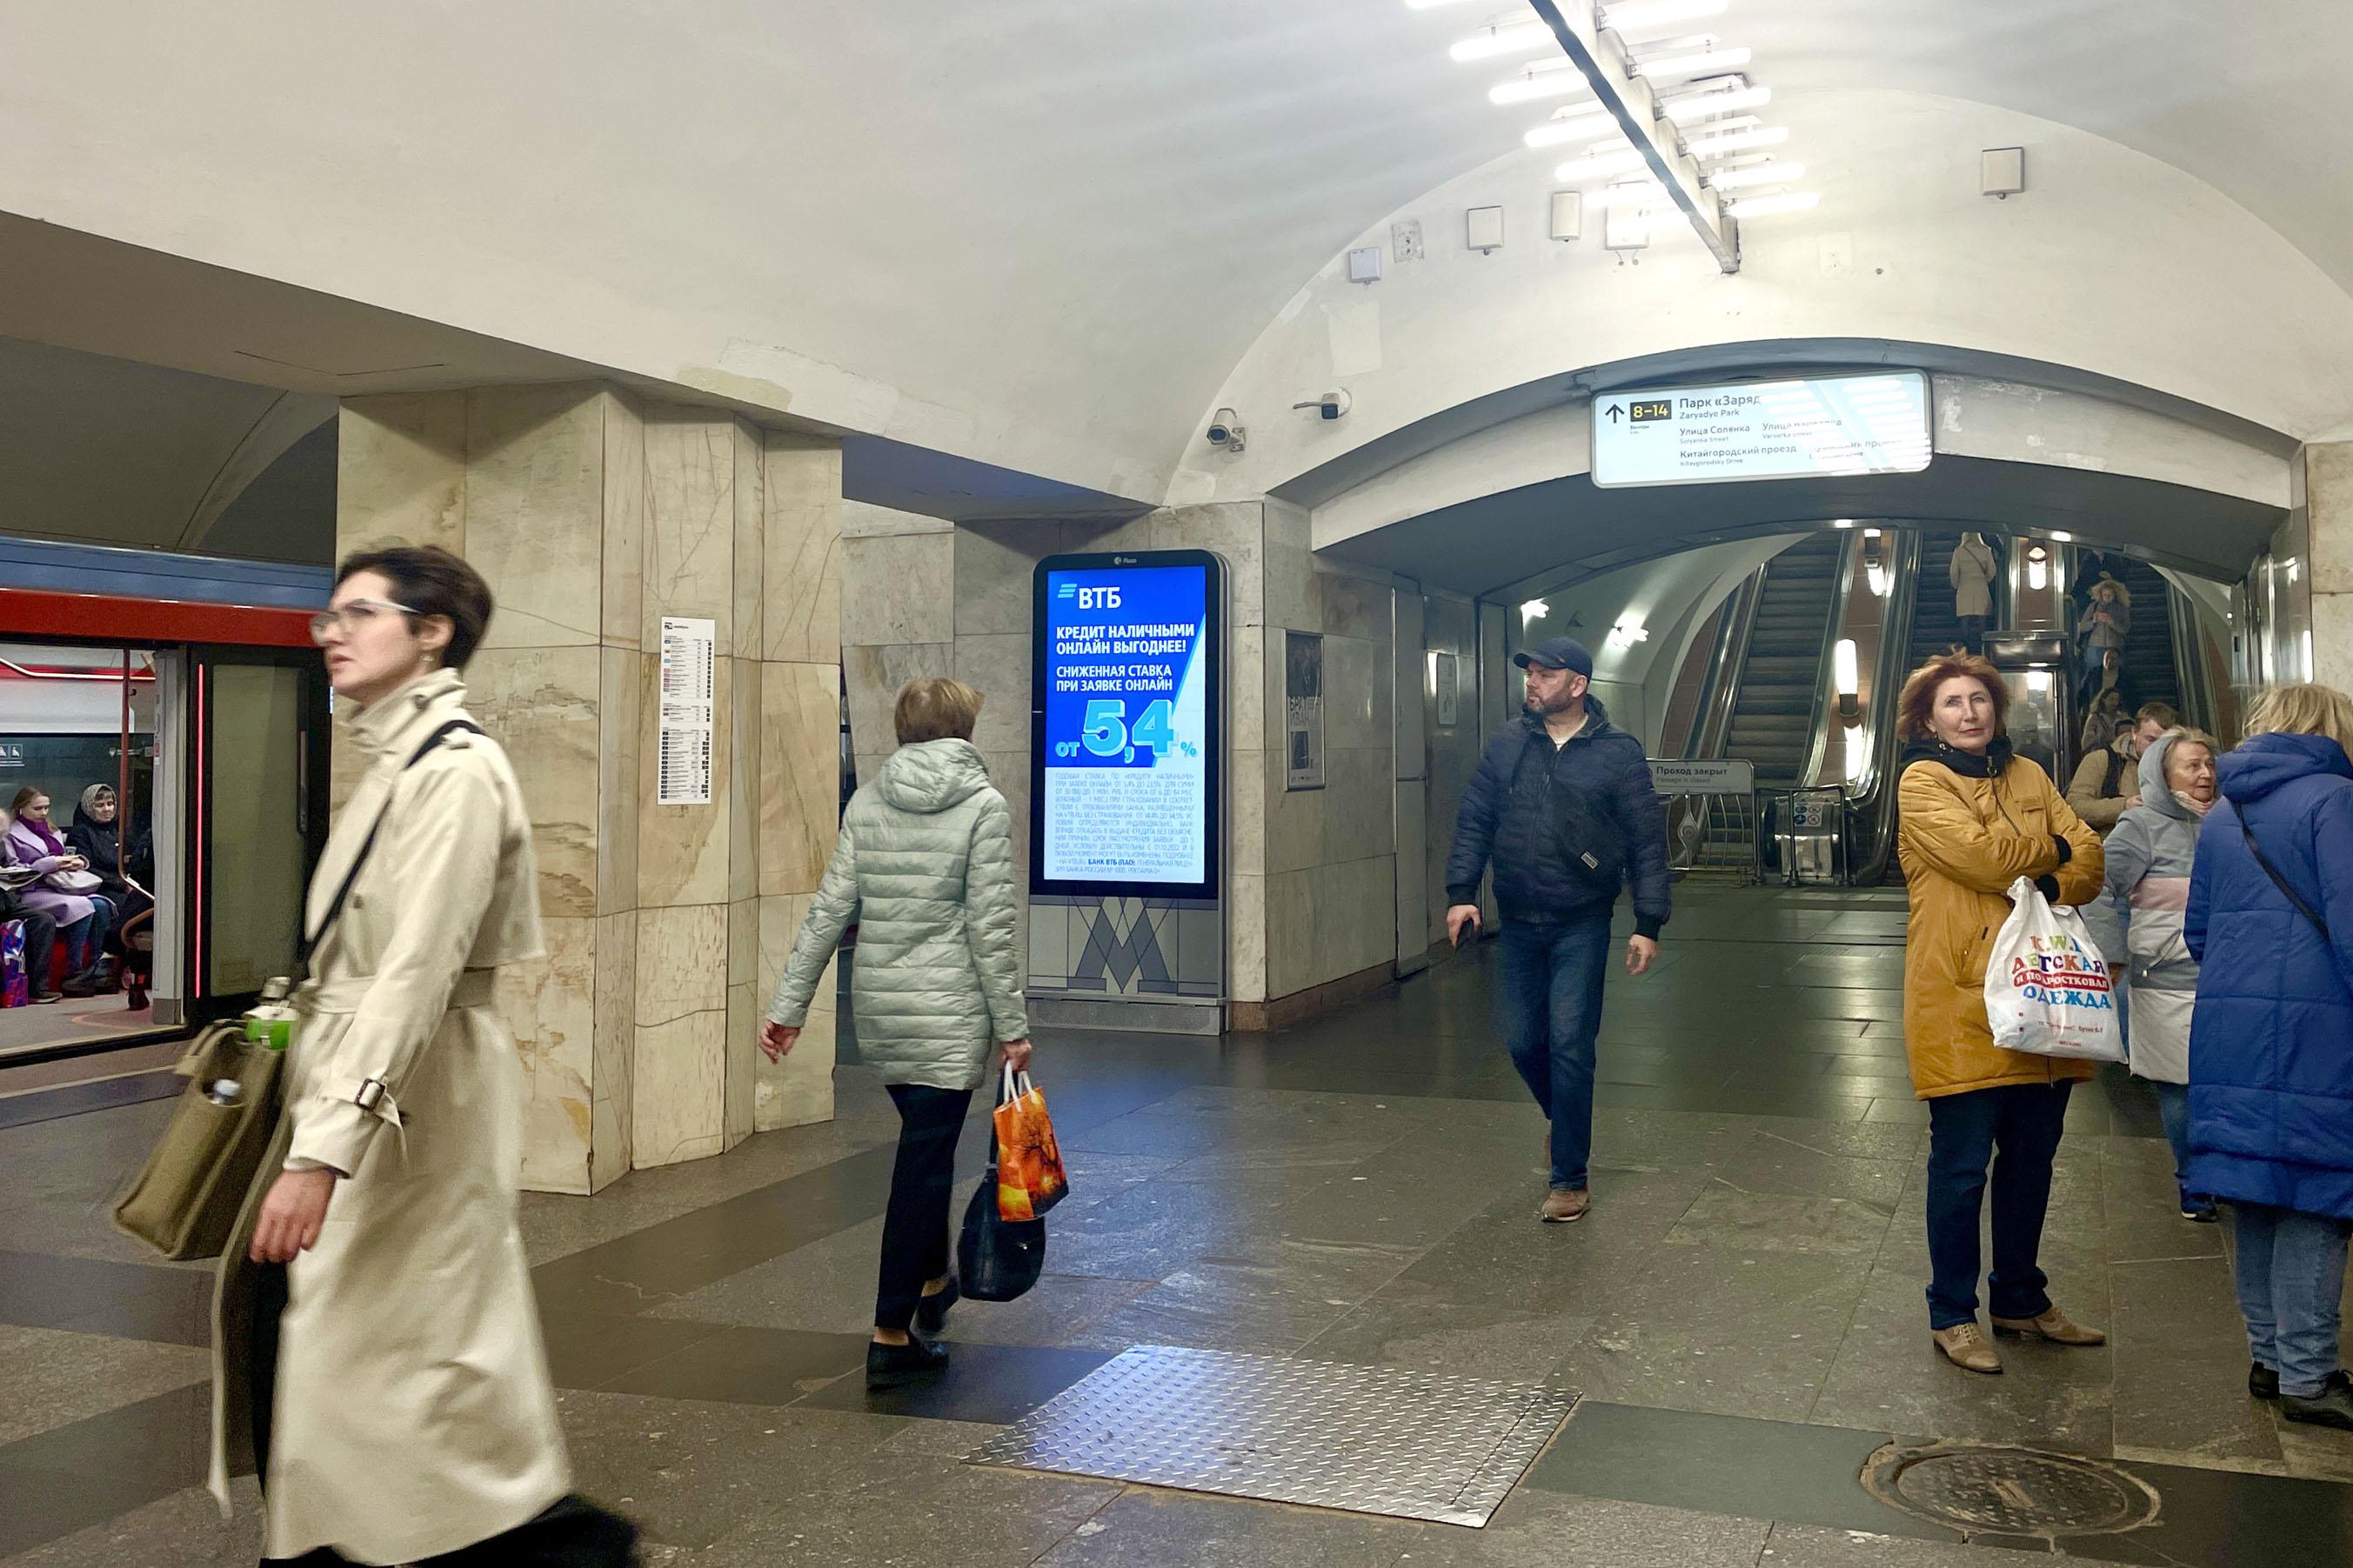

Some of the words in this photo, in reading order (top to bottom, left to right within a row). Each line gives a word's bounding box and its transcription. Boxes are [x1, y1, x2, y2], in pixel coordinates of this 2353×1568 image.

[1680, 397, 1712, 410] Парк
[1680, 410, 1719, 420] Zaryadye
[1721, 409, 1741, 417] Park
[1680, 427, 1708, 437] Улица
[1710, 425, 1750, 434] Солянка
[1761, 422, 1792, 431] Улица
[1680, 446, 1760, 458] Китайгородский
[1761, 445, 1797, 455] проезд
[1079, 586, 1121, 610] ВТБ
[1056, 625, 1106, 641] КРЕДИТ
[1108, 624, 1195, 639] НАЛИЧНЫМИ
[1056, 638, 1111, 655] ОНЛАЙН
[1113, 639, 1187, 656] ВЫГОДНЕЕ!
[1056, 665, 1126, 678] СНИЖЕННАЯ
[1127, 664, 1173, 677] СТАВКА
[1056, 680, 1079, 692] ПРИ
[1080, 678, 1123, 692] ЗАЯВКЕ
[1125, 677, 1173, 691] ОНЛАЙН
[1656, 766, 1692, 777] Проход
[1693, 768, 1728, 777] закрыт
[2012, 953, 2106, 975] ДЕТСКАЯ
[2016, 974, 2025, 984] И
[2023, 985, 2113, 1010] ОДЕЖДА
